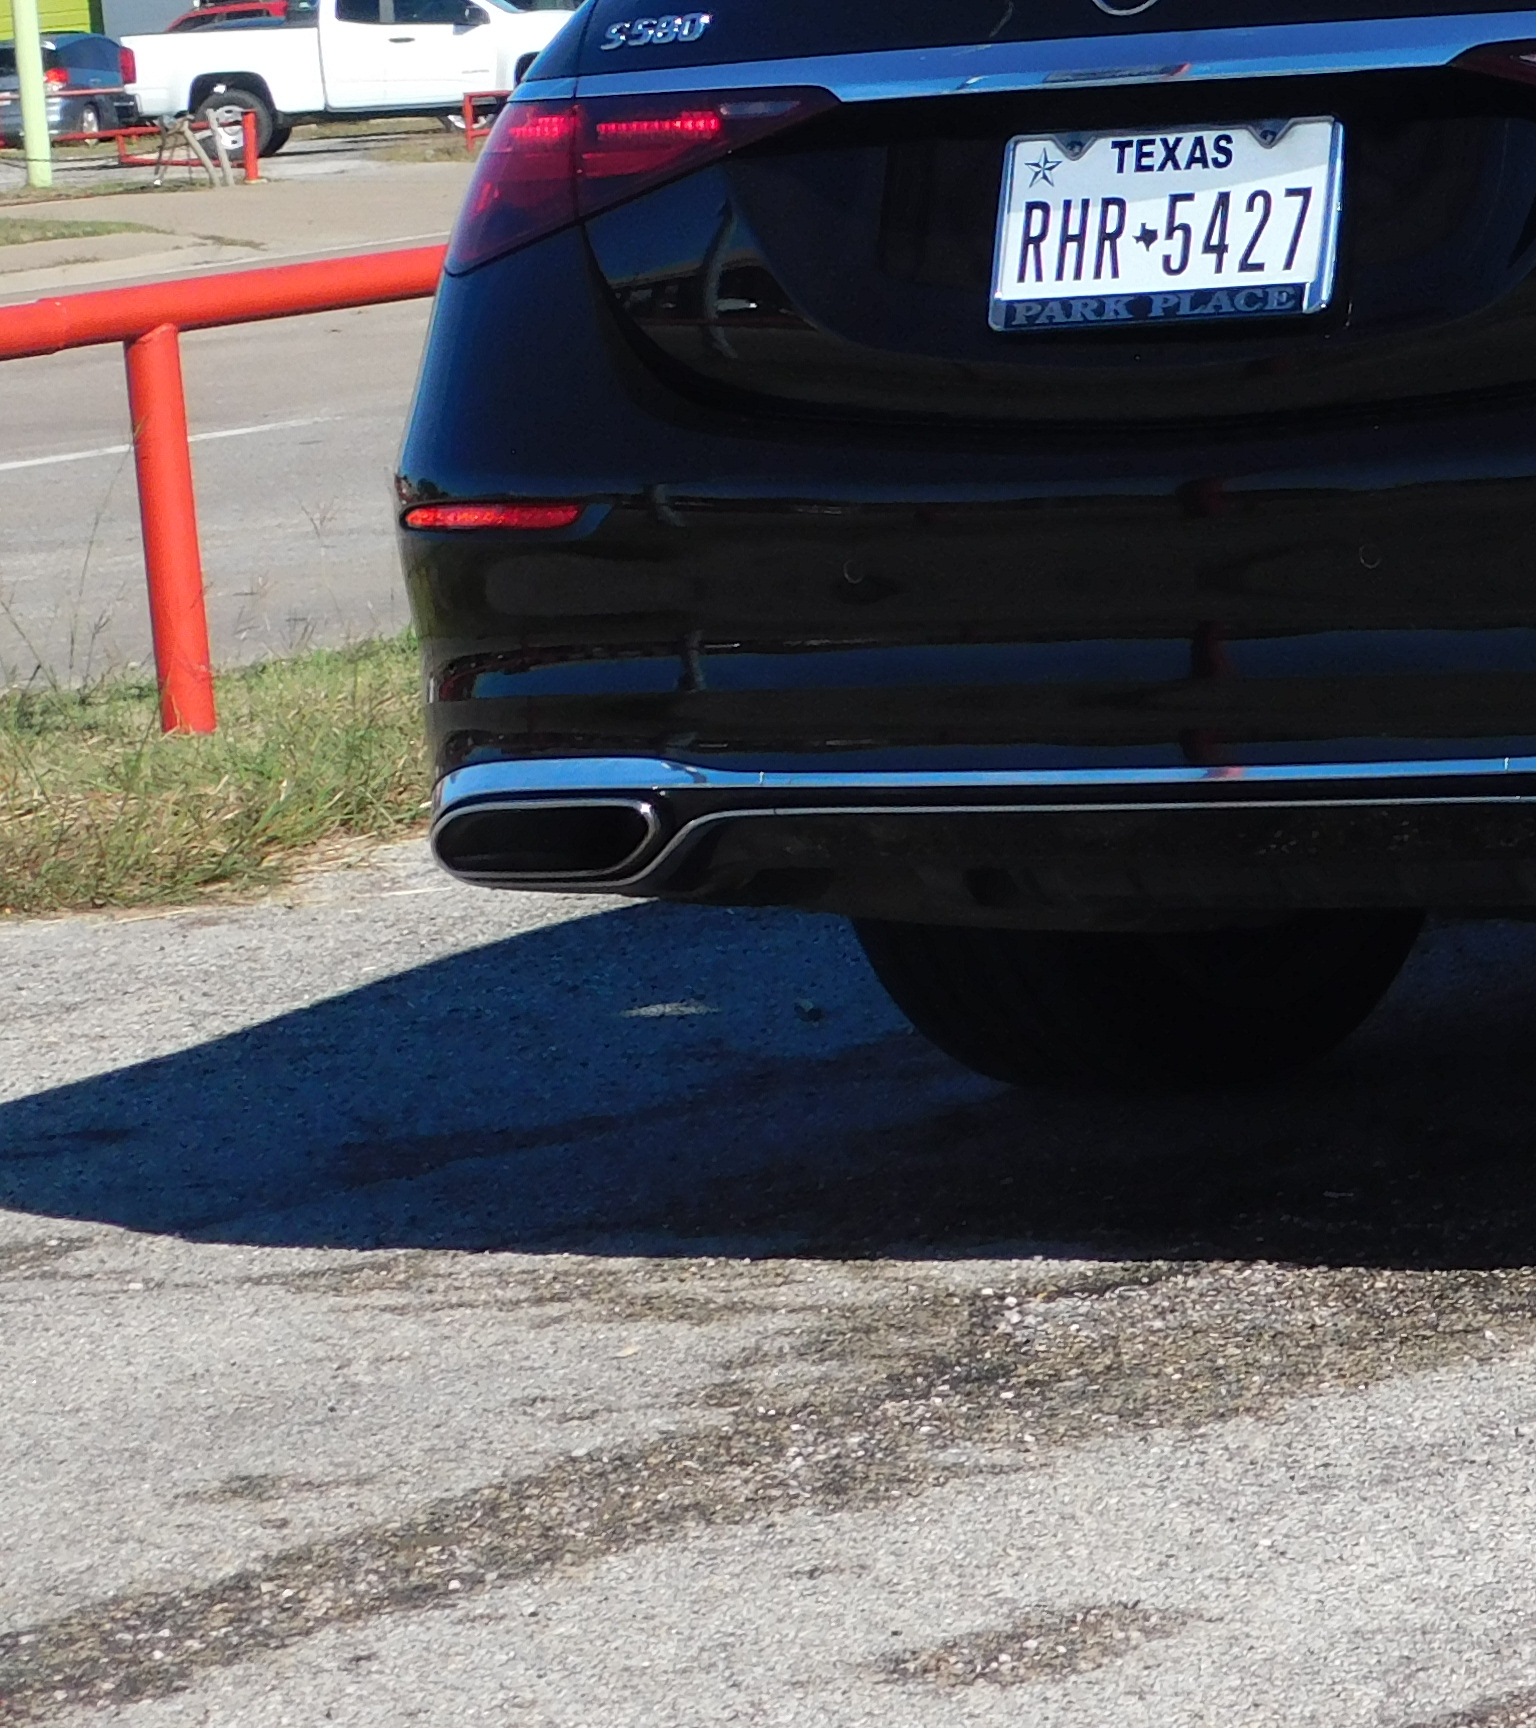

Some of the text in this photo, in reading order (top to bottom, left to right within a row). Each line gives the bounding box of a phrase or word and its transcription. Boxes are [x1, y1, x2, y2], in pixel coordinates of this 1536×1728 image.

[1111, 134, 1234, 174] TEXAS
[1016, 186, 1313, 284] RHR 5427
[1011, 284, 1297, 326] PARK PLACE
